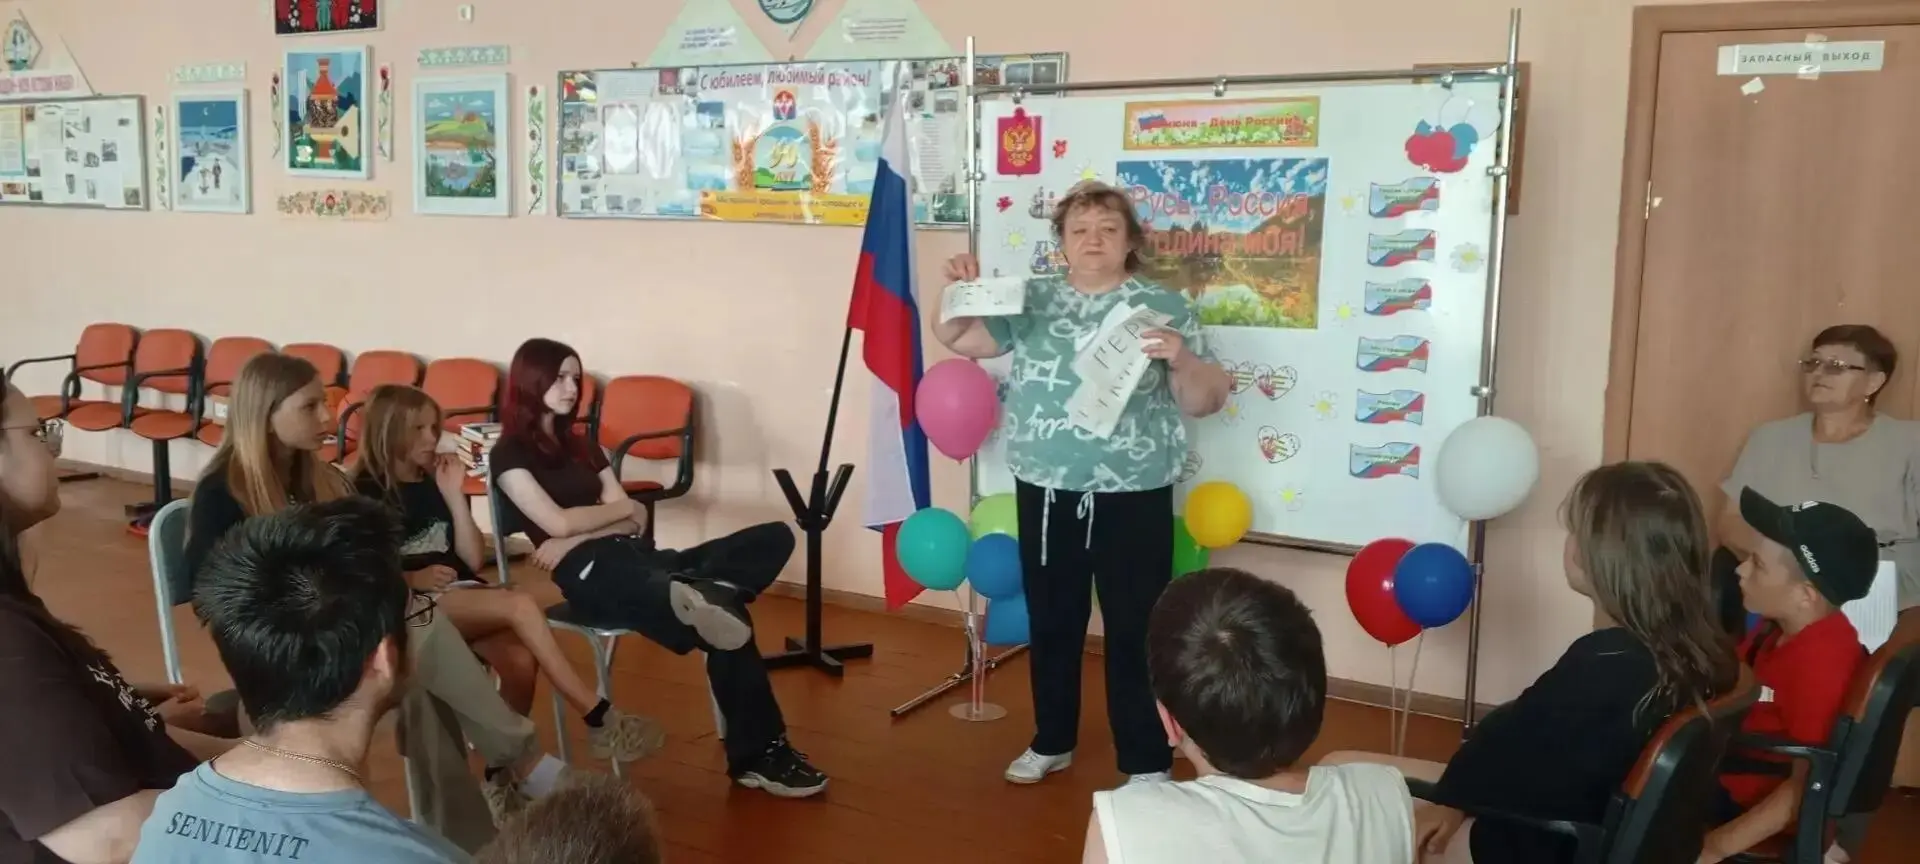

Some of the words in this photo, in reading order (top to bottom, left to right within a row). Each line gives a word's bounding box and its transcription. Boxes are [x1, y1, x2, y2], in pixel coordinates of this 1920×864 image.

[1740, 51, 1812, 63] ЗАПАСНЫЙ
[1822, 51, 1871, 63] ВЫХОД
[700, 74, 708, 90] С
[709, 71, 763, 90] юбилеем,
[766, 66, 825, 85] любимый
[1207, 183, 1316, 224] Россия,
[165, 811, 310, 861] SENITENIT
